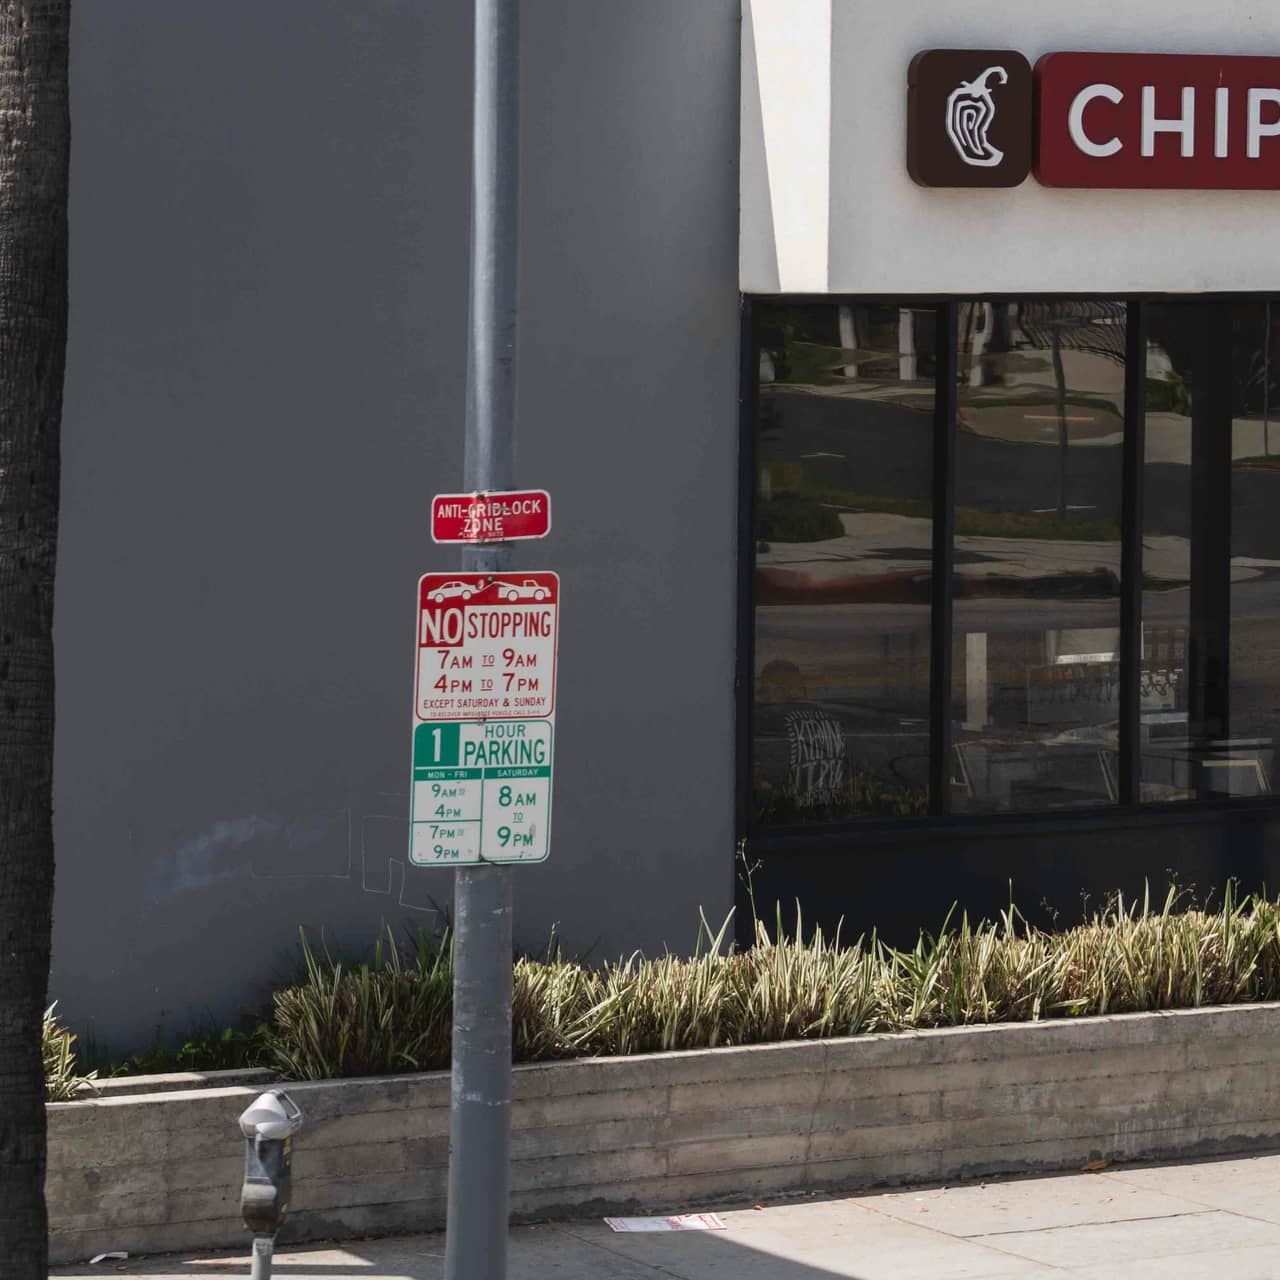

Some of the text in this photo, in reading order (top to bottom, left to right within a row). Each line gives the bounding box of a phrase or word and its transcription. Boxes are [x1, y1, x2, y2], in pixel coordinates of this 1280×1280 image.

[437, 500, 541, 519] ANTI-GRIDLOCK
[463, 517, 503, 533] ZONE
[420, 607, 551, 644] NO STOPPING
[423, 696, 546, 709] EXCEPT SATURDAY & SUNDAY
[484, 724, 526, 739] HOUR
[431, 728, 442, 762] 1
[464, 739, 545, 766] PARKING
[497, 768, 539, 777] SATURDAY
